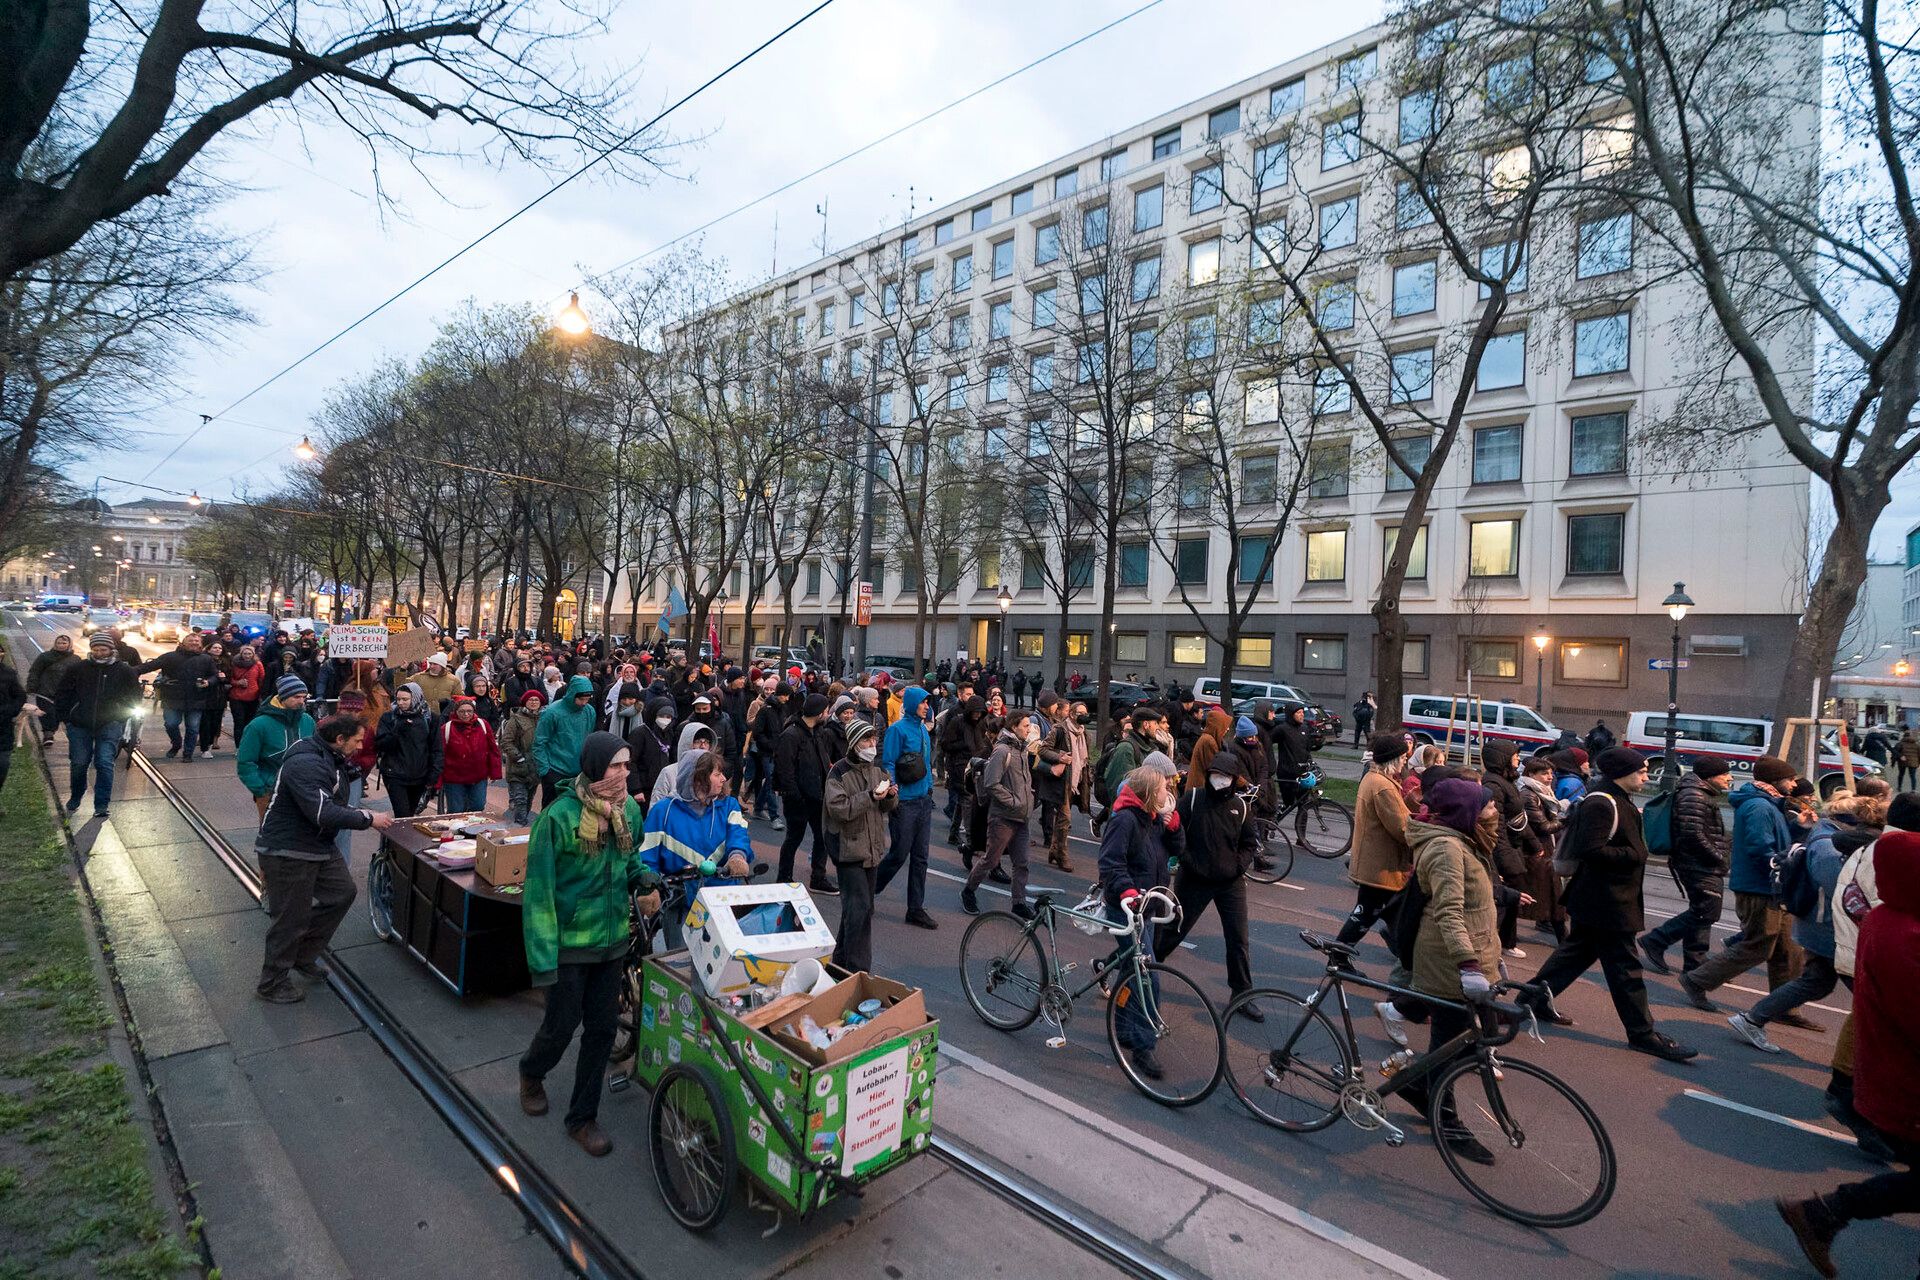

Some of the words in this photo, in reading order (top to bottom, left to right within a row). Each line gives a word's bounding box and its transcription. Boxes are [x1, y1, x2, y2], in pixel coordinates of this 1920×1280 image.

[331, 626, 387, 635] KLIMASCHUTZ
[331, 643, 387, 655] VERBRECHEN
[863, 1063, 888, 1079] Lobau
[855, 1070, 899, 1095] Autobahn?
[869, 1089, 886, 1102] Hier
[856, 1098, 895, 1122] verbrennt
[851, 1122, 897, 1152] Steuergeld!
